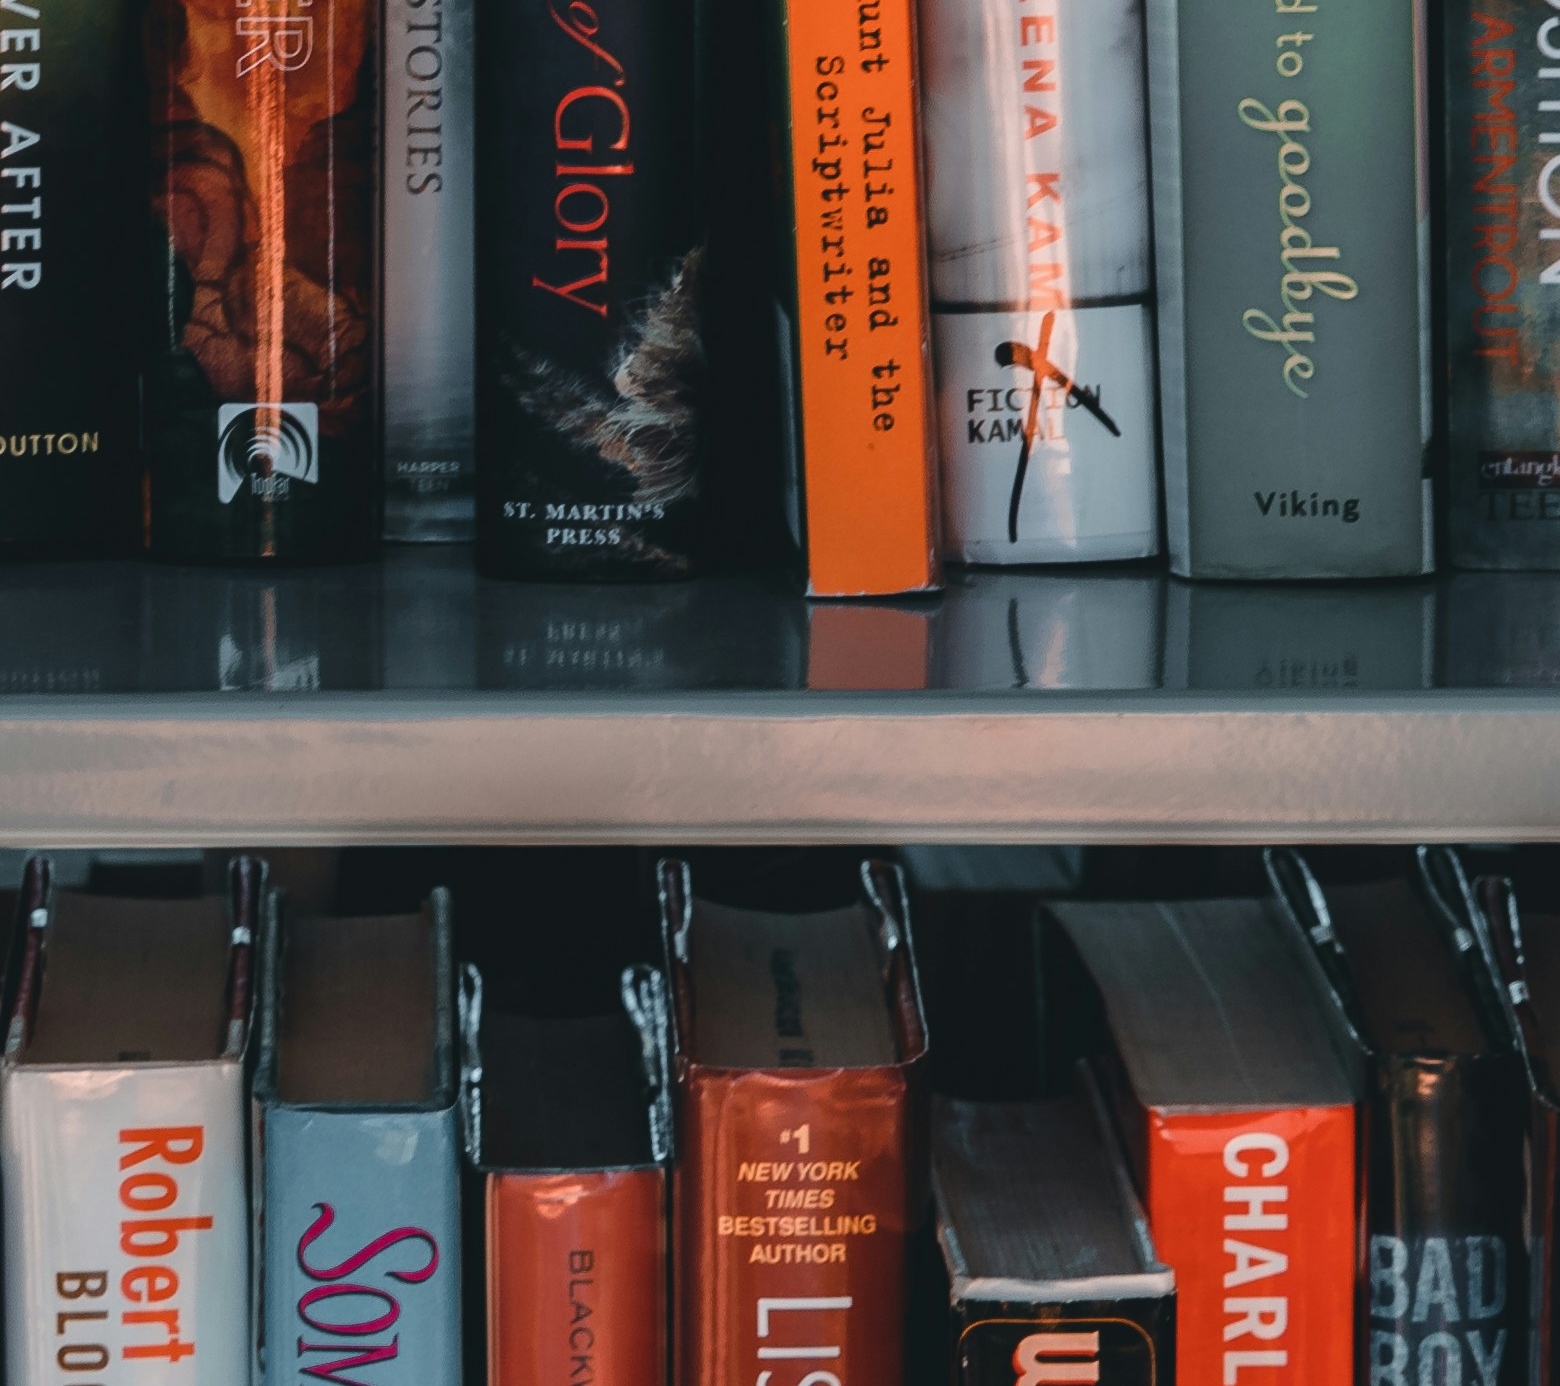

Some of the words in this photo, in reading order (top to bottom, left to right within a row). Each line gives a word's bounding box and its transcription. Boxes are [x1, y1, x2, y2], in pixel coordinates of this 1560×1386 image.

[1273, 33, 1315, 78] to
[0, 121, 42, 293] AFTER
[531, 86, 635, 320] Glory
[814, 55, 853, 363] Scriptwriter
[861, 107, 896, 232] Julia
[869, 257, 899, 334] and
[1237, 98, 1359, 400] goodbye
[871, 359, 896, 434] the
[1252, 490, 1360, 523] Viking
